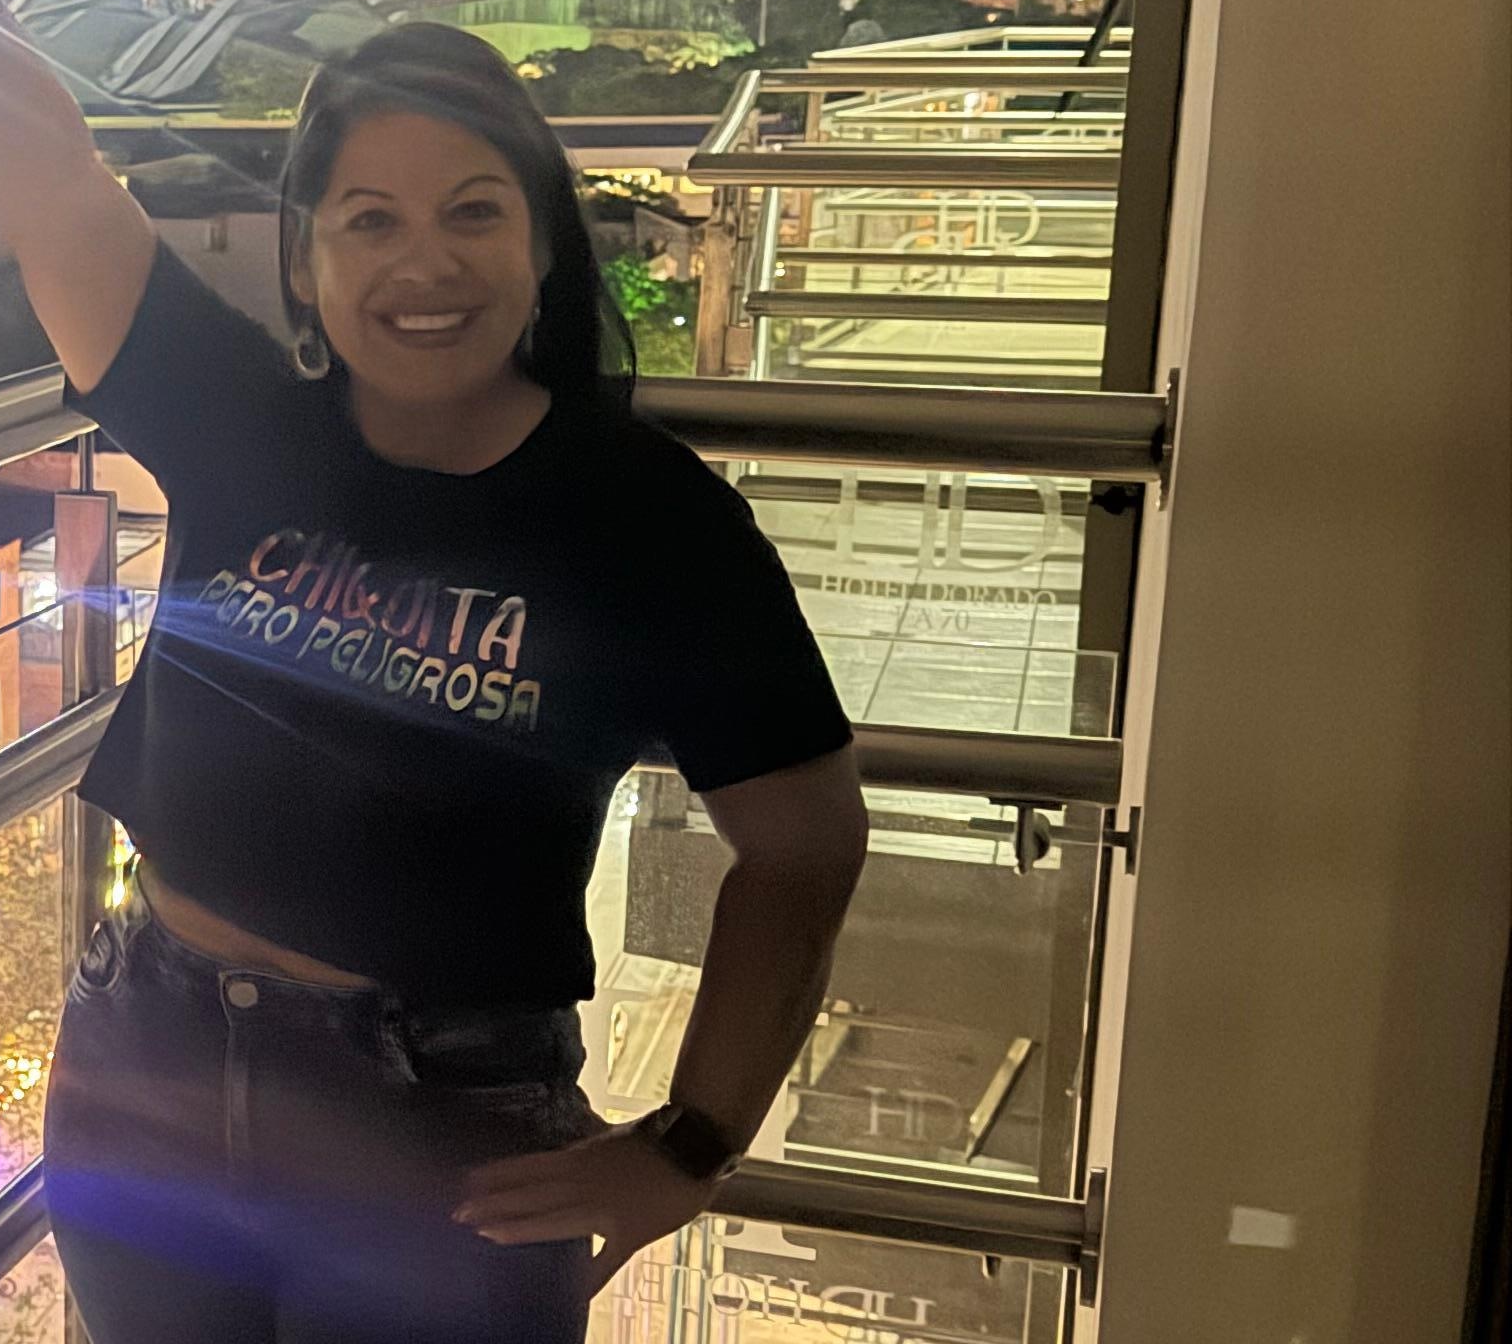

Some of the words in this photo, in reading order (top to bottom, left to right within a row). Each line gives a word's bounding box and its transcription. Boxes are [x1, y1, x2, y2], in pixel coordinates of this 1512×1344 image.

[249, 527, 528, 669] CHIQUITA
[820, 573, 917, 600] HOTEL
[925, 581, 1058, 612] DORADO
[940, 607, 970, 633] 70
[198, 568, 300, 644] PERO
[295, 616, 542, 733] PELIGROSA
